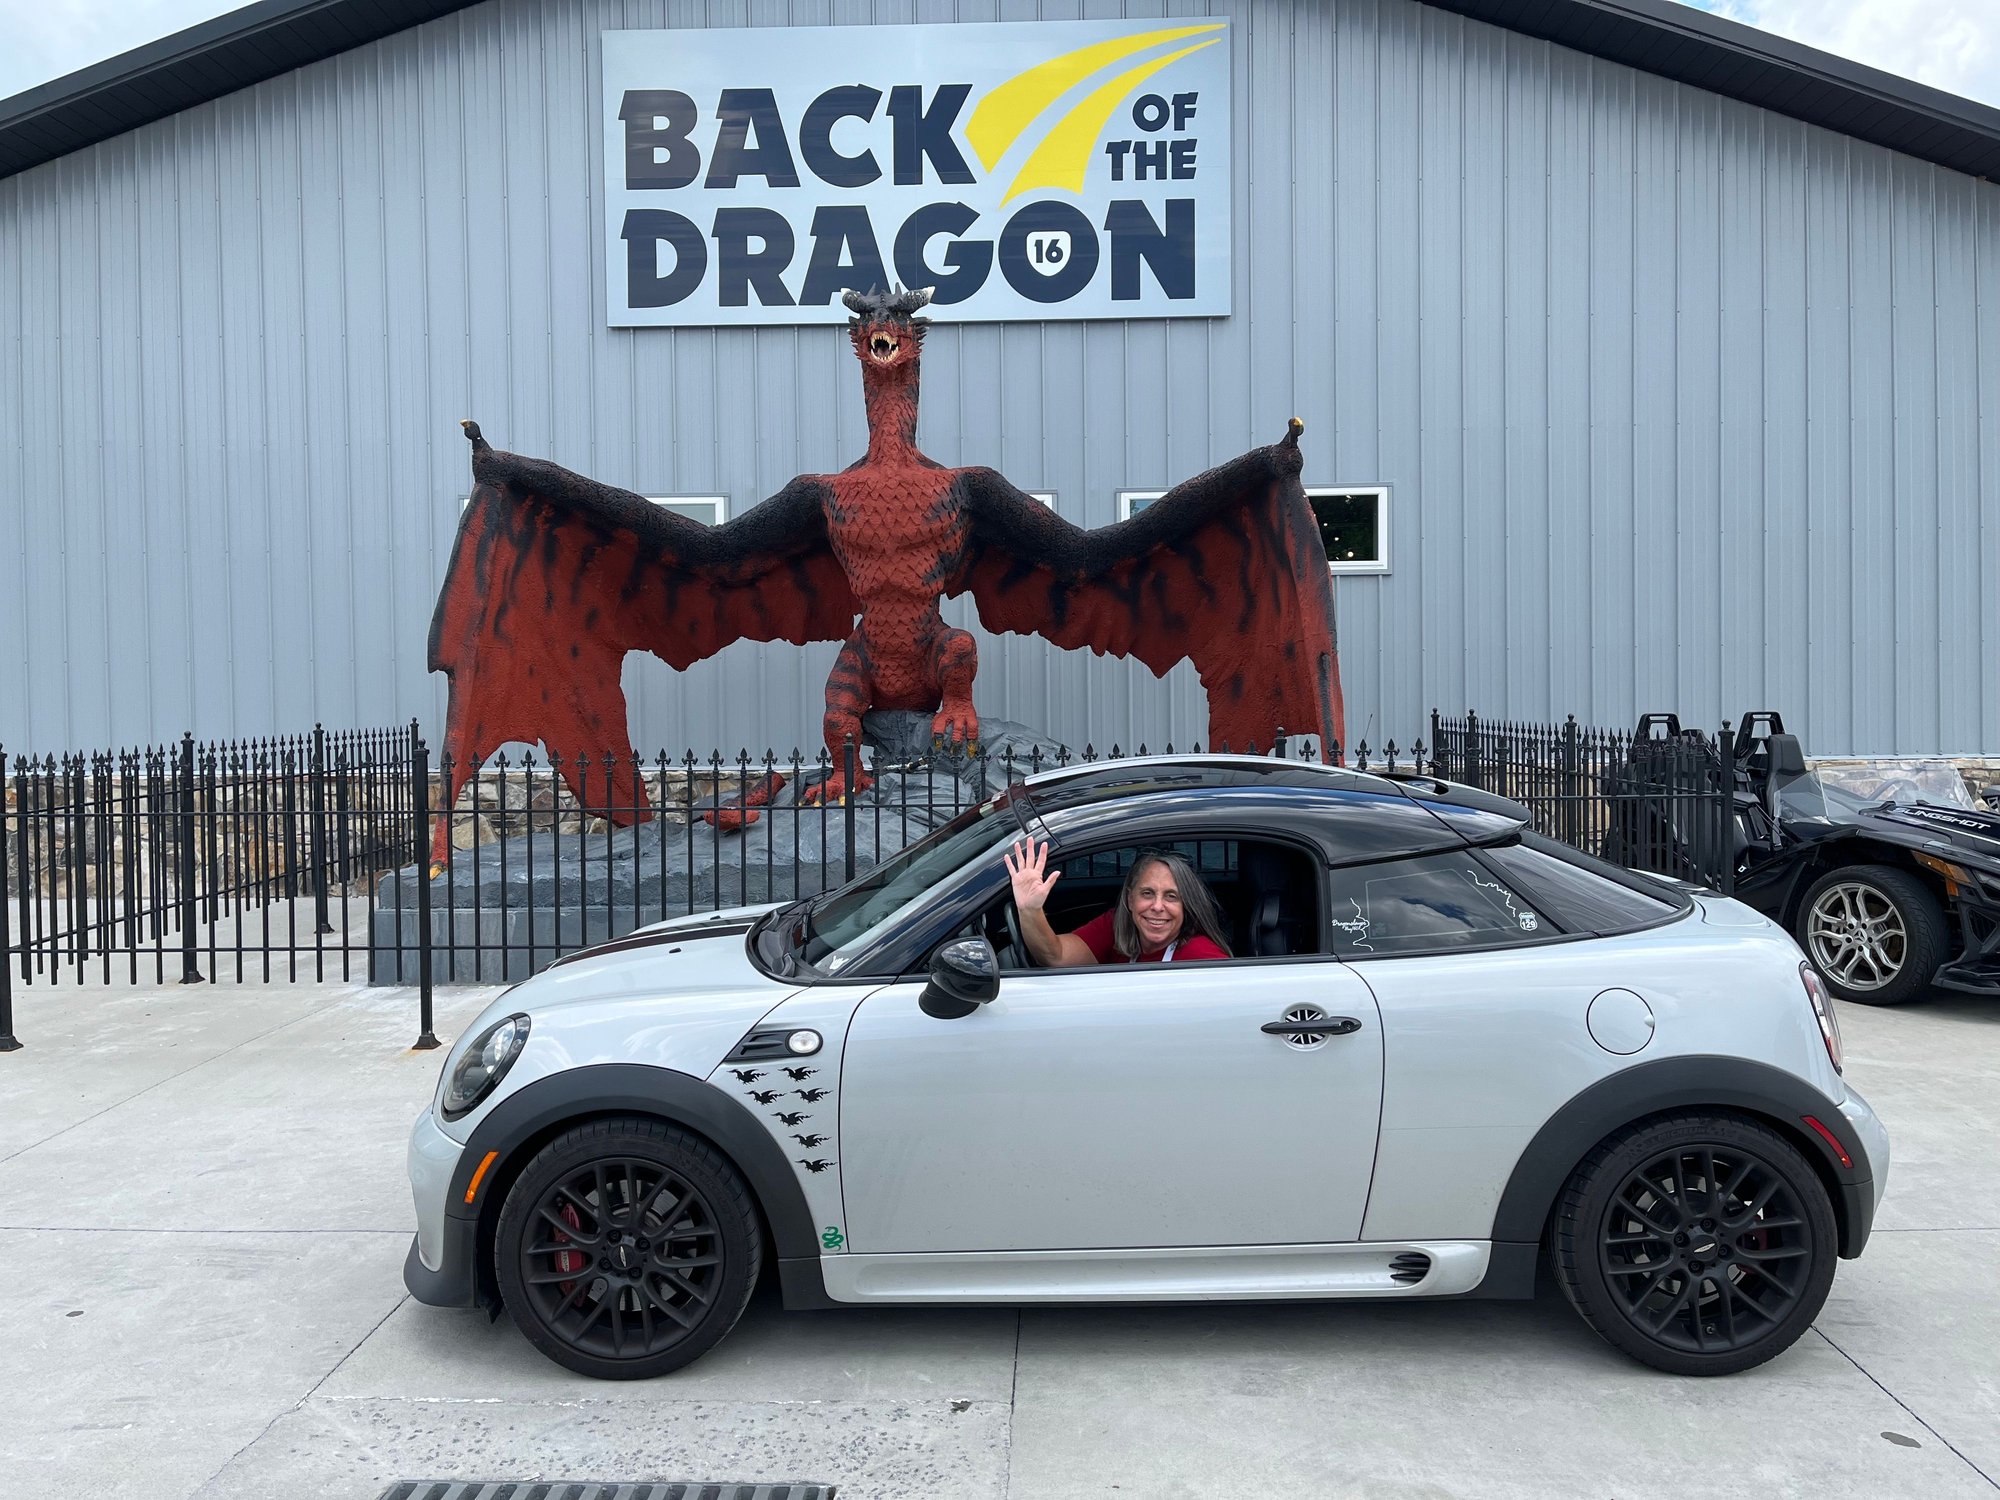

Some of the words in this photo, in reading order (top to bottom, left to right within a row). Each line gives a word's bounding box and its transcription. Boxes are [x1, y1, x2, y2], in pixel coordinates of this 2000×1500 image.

[1132, 91, 1199, 132] OF
[618, 83, 977, 190] BACK
[1105, 138, 1198, 181] THE
[620, 198, 1196, 309] DRAGON
[1034, 238, 1064, 264] 16
[1888, 807, 1991, 829] SLINGSHOT
[1521, 919, 1536, 929] 129
